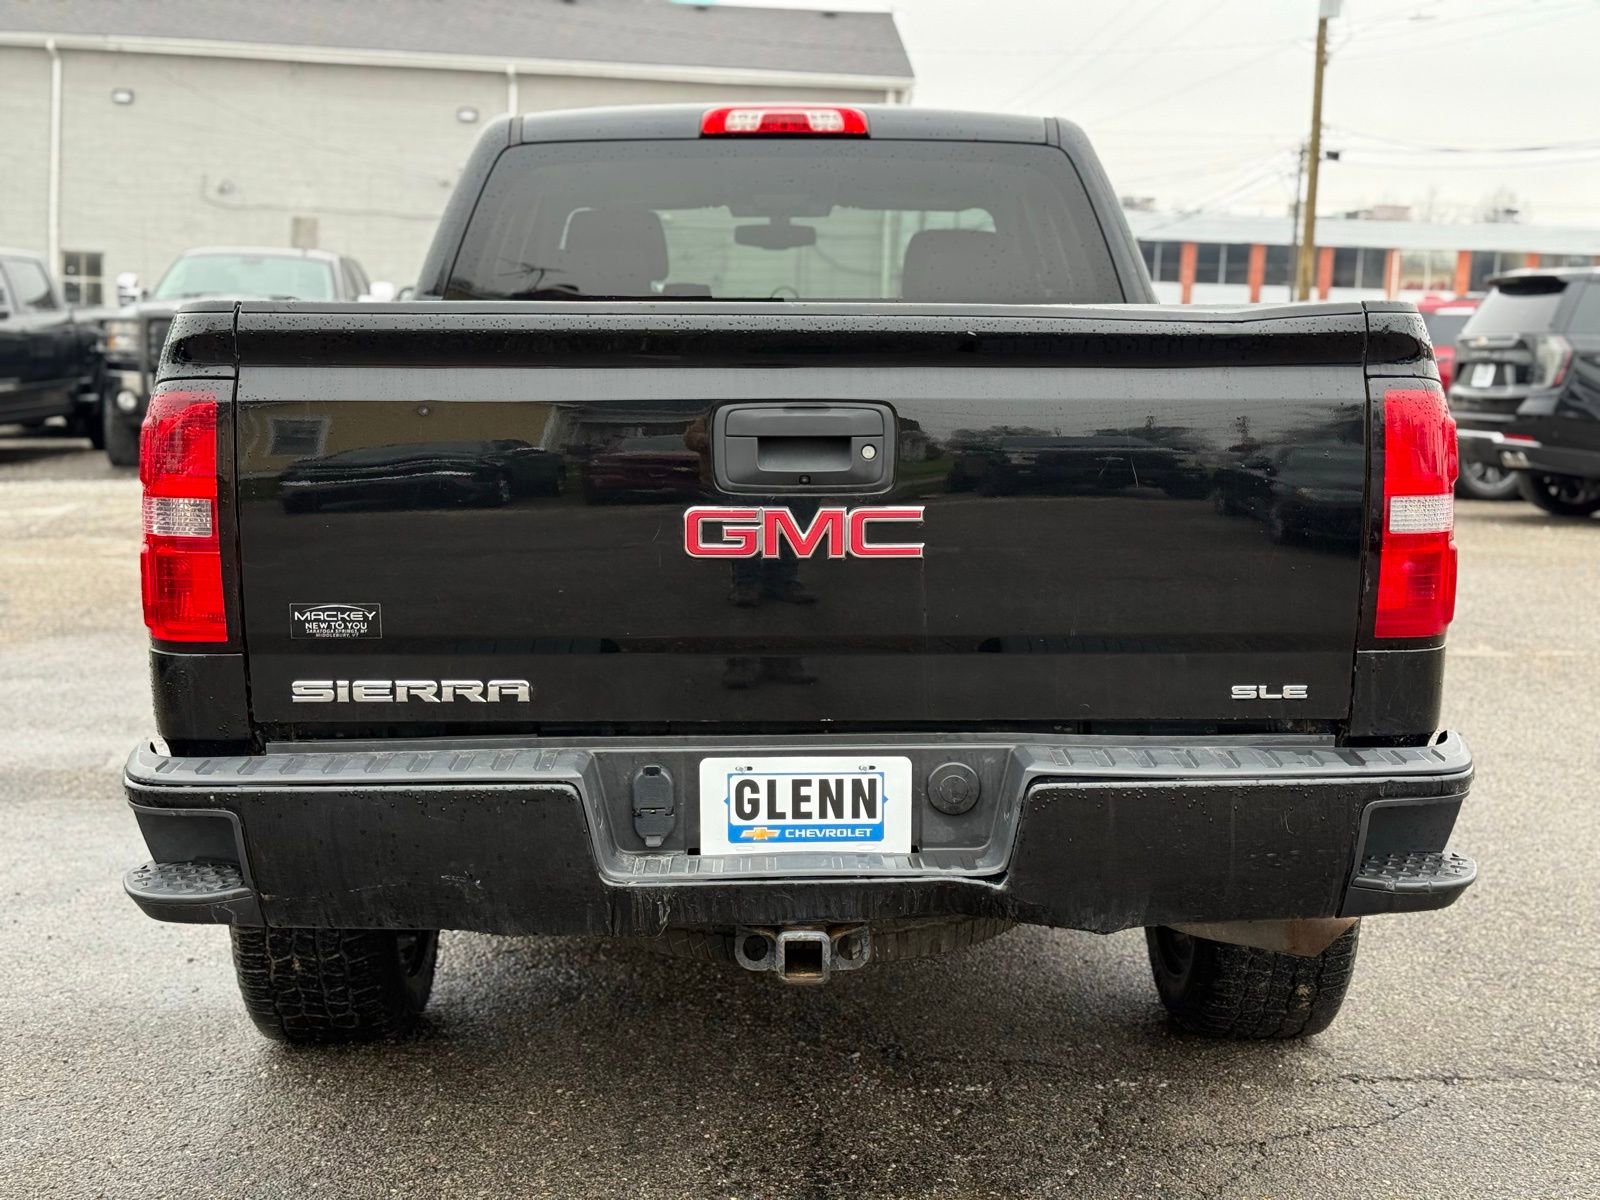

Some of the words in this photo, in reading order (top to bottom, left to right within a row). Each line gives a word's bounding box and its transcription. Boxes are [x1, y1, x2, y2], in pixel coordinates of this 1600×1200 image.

[684, 505, 926, 559] GMC
[294, 611, 376, 621] MACKEY
[330, 621, 344, 629] TO
[291, 679, 531, 703] SIERRA
[1231, 685, 1308, 699] SLE
[734, 778, 877, 821] GLENN
[785, 828, 873, 838] CHEVROLET
